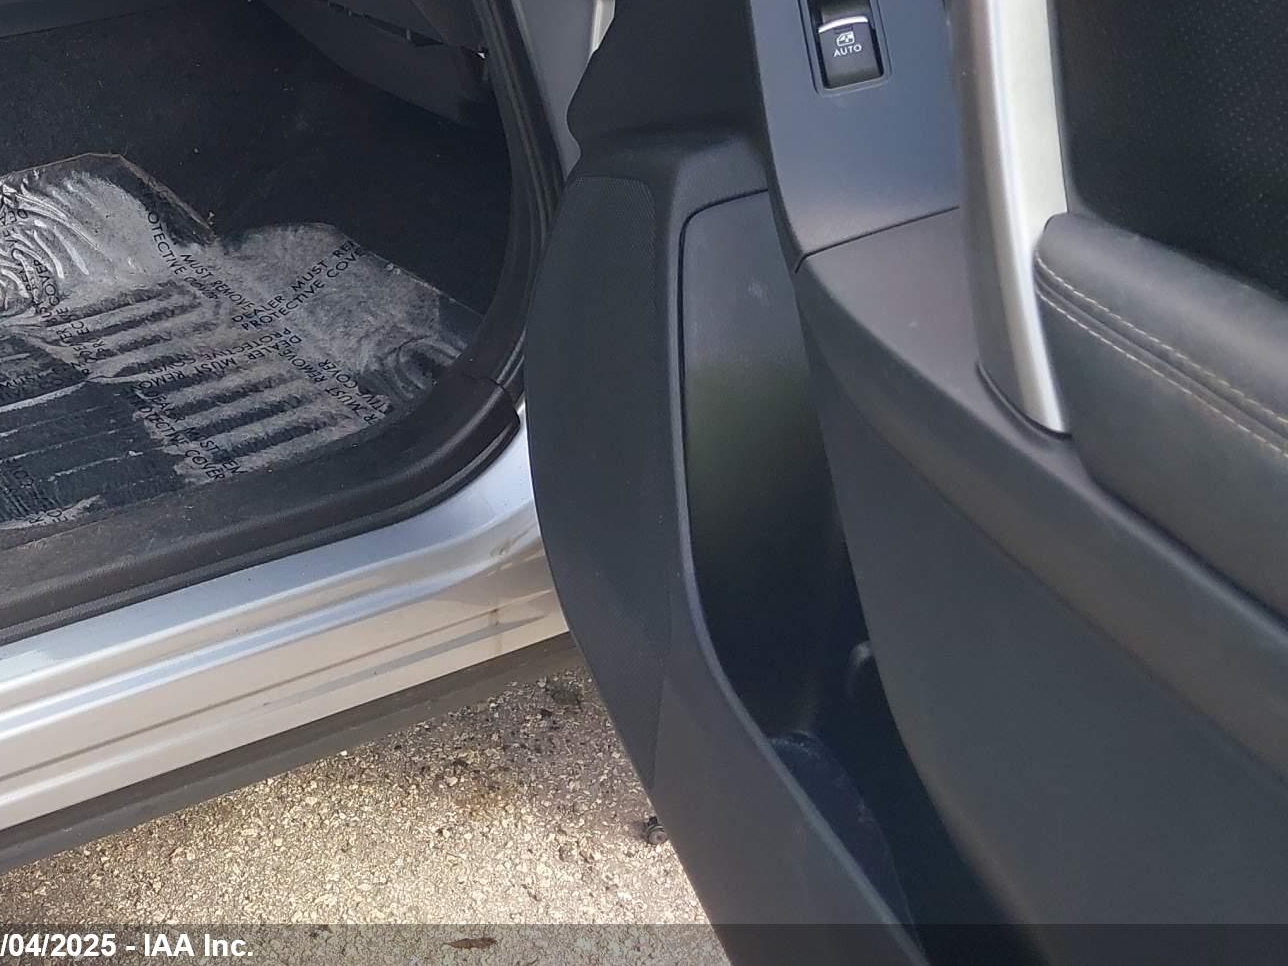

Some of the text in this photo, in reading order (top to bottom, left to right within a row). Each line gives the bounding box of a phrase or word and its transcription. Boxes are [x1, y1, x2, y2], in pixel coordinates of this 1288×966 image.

[833, 43, 862, 58] AUTO
[180, 253, 214, 279] MUST
[232, 295, 286, 323] DEALER
[291, 260, 330, 293] MUST
[241, 281, 325, 331] PROTECTIVE
[201, 327, 292, 361] PROTECTIVE
[248, 334, 302, 362] DEALER
[278, 352, 365, 417] MUST REMOVE
[317, 359, 359, 390] COVER
[184, 449, 226, 481] COVER
